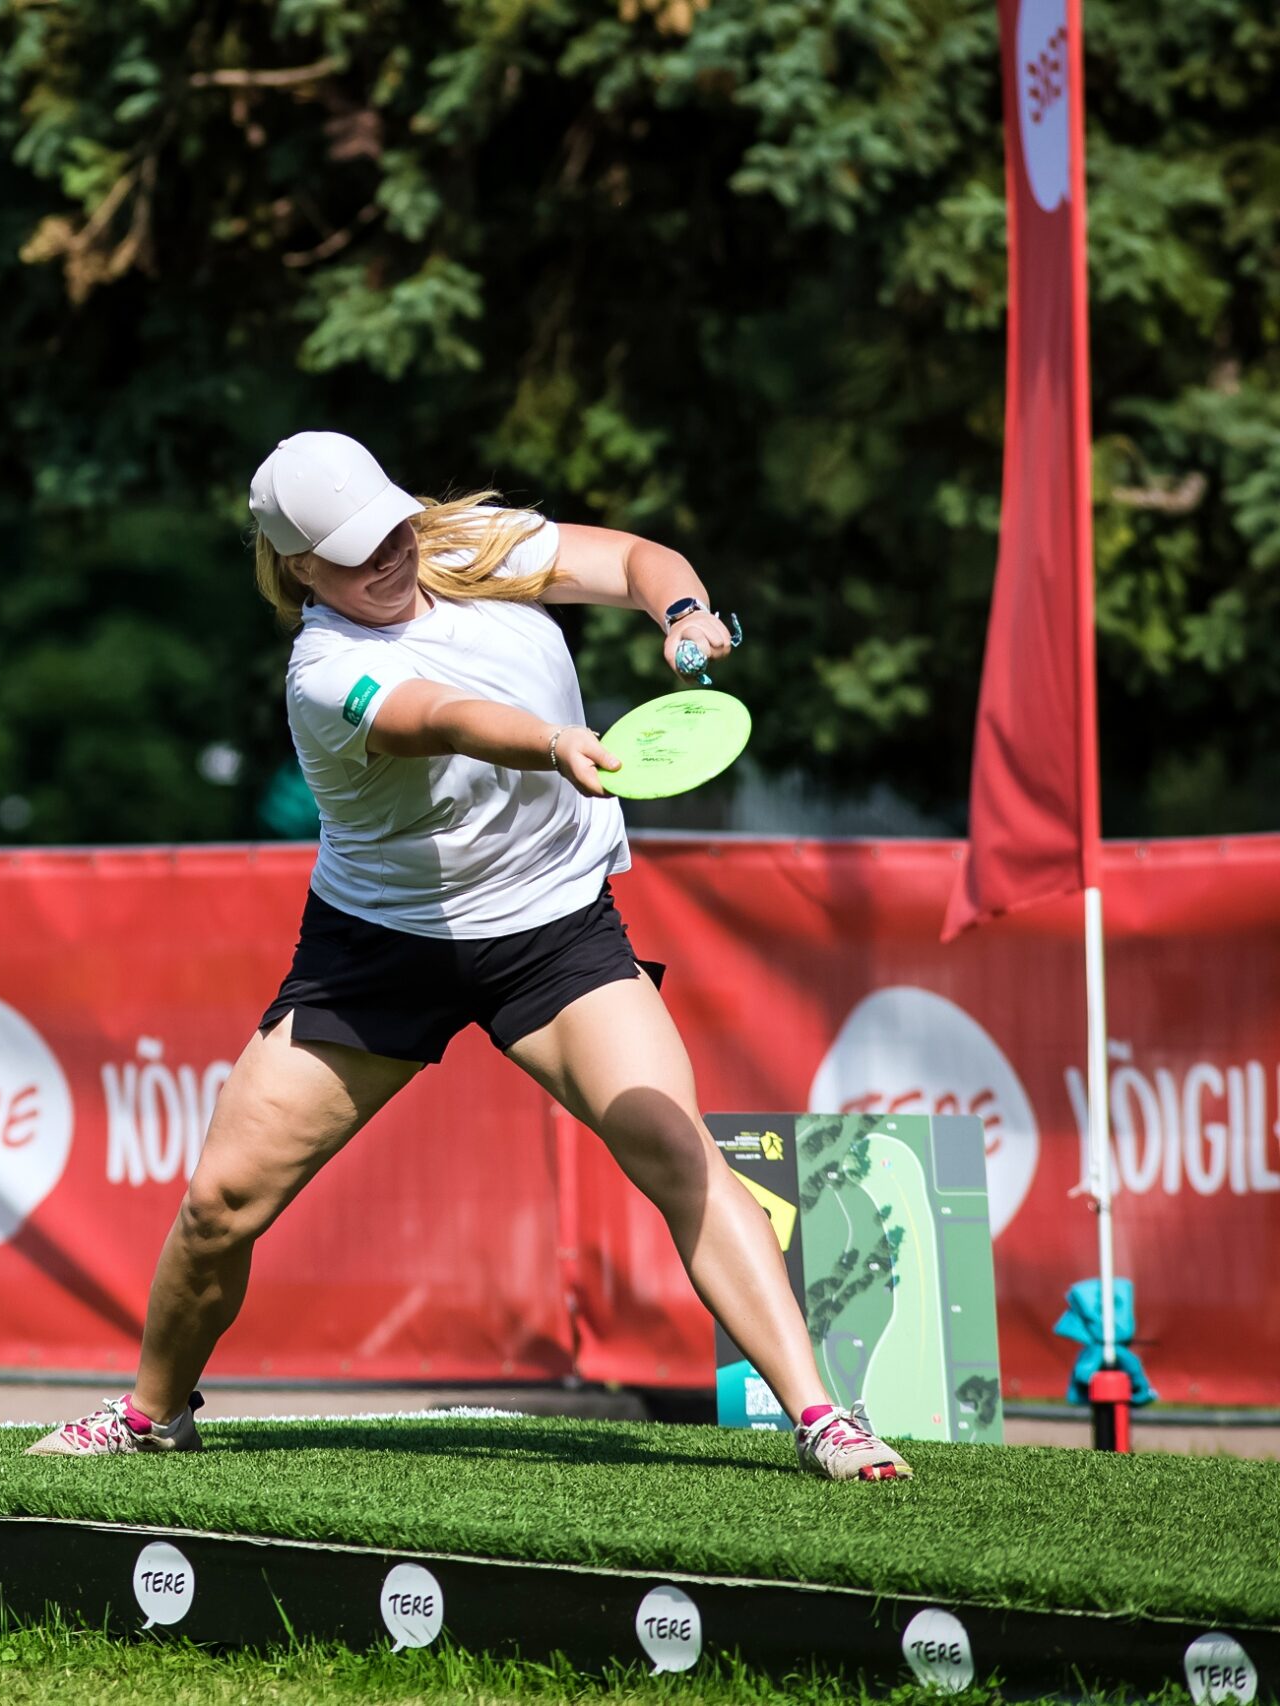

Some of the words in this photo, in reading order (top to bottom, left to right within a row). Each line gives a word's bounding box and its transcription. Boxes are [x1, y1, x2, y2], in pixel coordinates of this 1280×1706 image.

[141, 1571, 186, 1595] TERE
[388, 1593, 434, 1618] TERE
[644, 1616, 692, 1642] TERE
[910, 1640, 962, 1666] TERE
[1193, 1664, 1247, 1691] TERE
